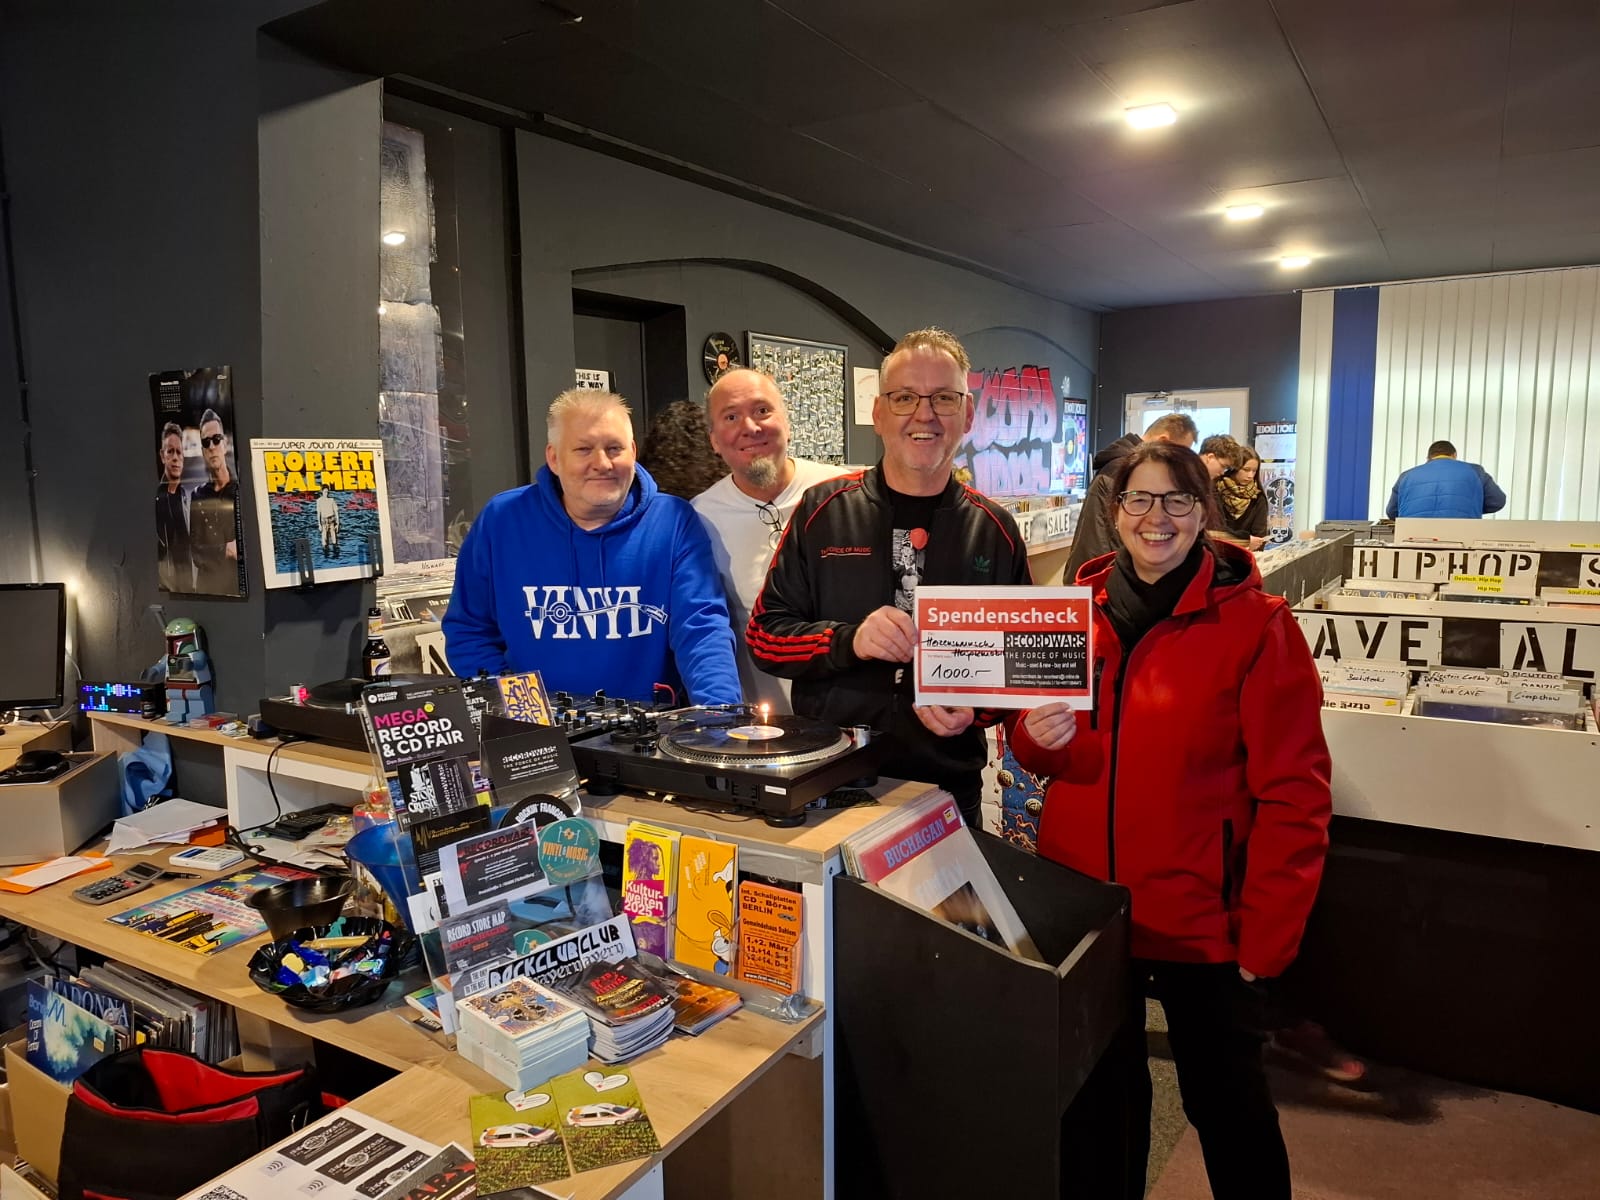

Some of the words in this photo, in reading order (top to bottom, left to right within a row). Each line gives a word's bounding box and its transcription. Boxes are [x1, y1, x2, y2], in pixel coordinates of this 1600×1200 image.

[588, 381, 604, 389] WAY
[264, 451, 374, 471] ROBERT
[267, 470, 376, 493] PALMER
[1048, 512, 1070, 535] SALE
[522, 585, 652, 640] VINYL
[927, 607, 1078, 626] Spendenscheck
[1006, 634, 1086, 648] RECORDWARS
[1311, 617, 1429, 667] AVE
[1006, 651, 1019, 659] THE
[1023, 651, 1046, 659] FORCE
[1063, 651, 1086, 659] MUSIC
[374, 708, 429, 729] MEGA
[378, 718, 452, 743] RECORD
[383, 743, 396, 758] &
[397, 737, 423, 754] CD
[425, 729, 464, 749] FAIR
[626, 880, 664, 900] Kultur-
[754, 889, 797, 905] Schallplatten
[623, 900, 653, 917] 2025
[625, 893, 664, 911] welten
[742, 902, 773, 915] BERLIN
[743, 895, 757, 903] CD
[765, 899, 793, 911] Börse
[446, 921, 471, 942] RECORD
[472, 915, 492, 932] STORE
[492, 911, 506, 927] MAP
[768, 941, 789, 952] März
